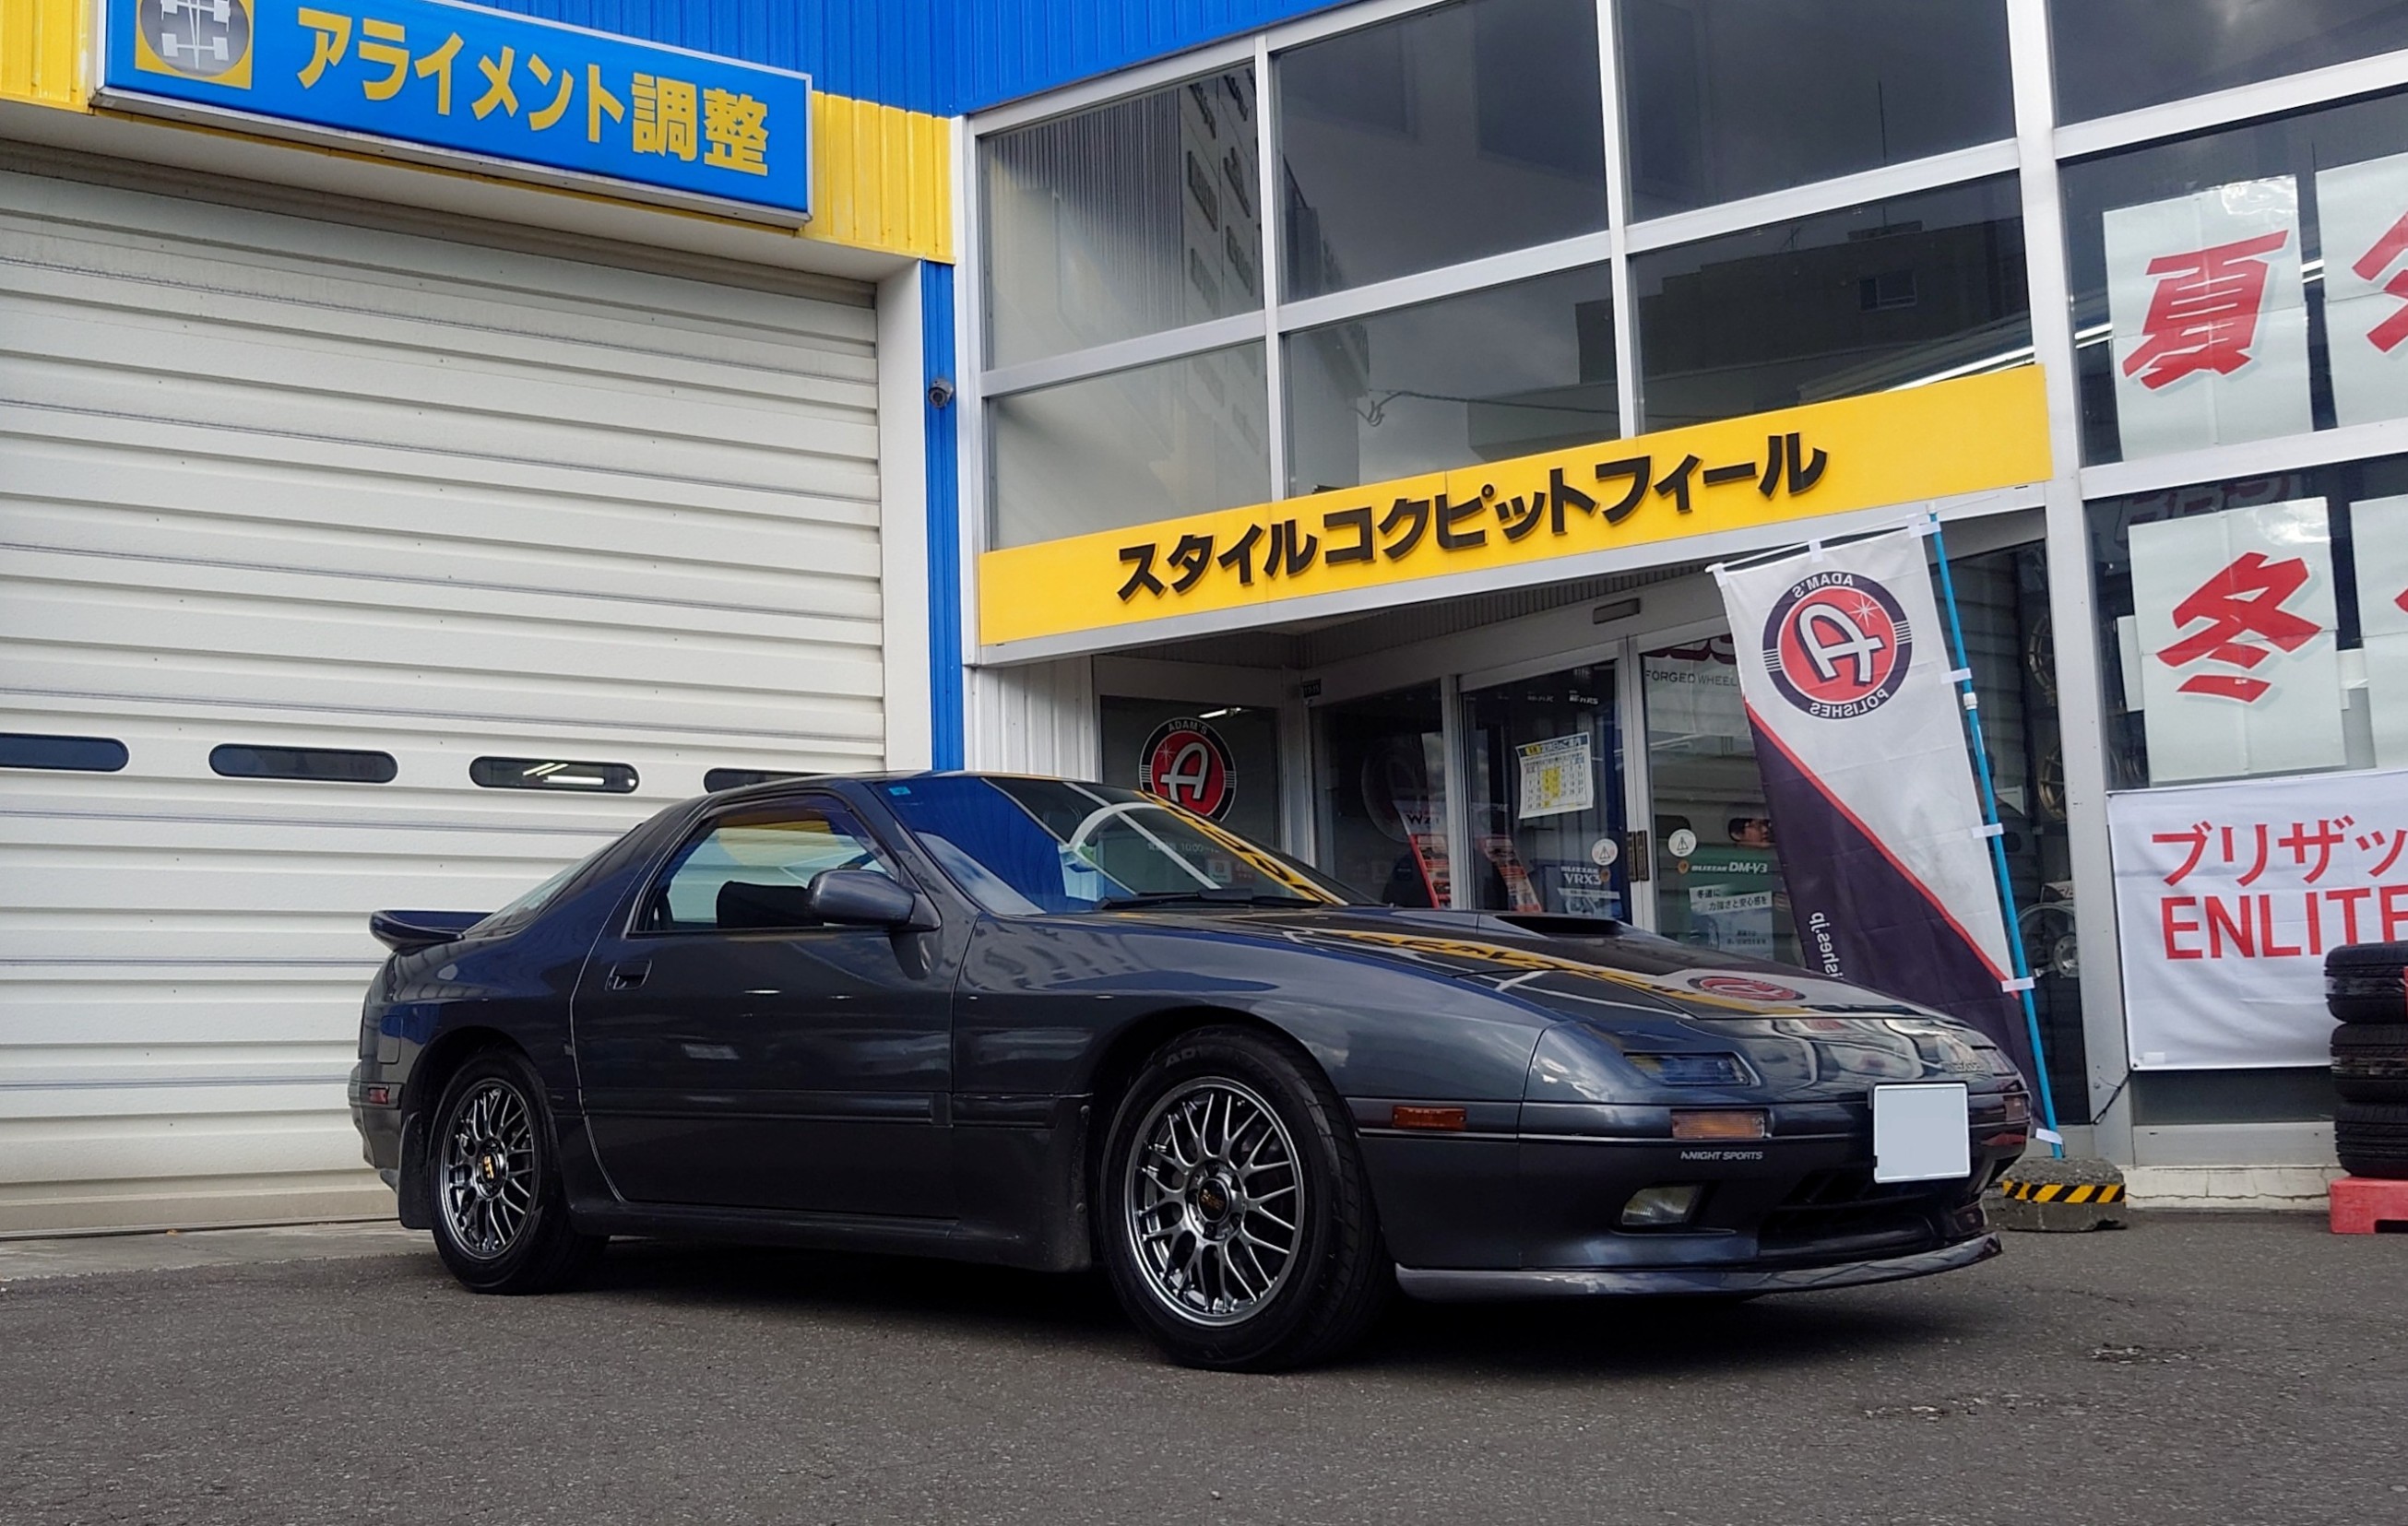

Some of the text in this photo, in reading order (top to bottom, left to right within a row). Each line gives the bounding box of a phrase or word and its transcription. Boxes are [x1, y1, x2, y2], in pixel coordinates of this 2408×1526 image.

[297, 7, 769, 177] アライメント調整
[1117, 432, 1829, 604] スタイルコクピットフィール
[2156, 551, 2408, 704] 冬
[1168, 720, 1208, 735] ADAM'S
[1563, 873, 1602, 885] VRX3
[2152, 815, 2408, 886] ブリザッ
[1722, 1151, 1763, 1160] SPORTS
